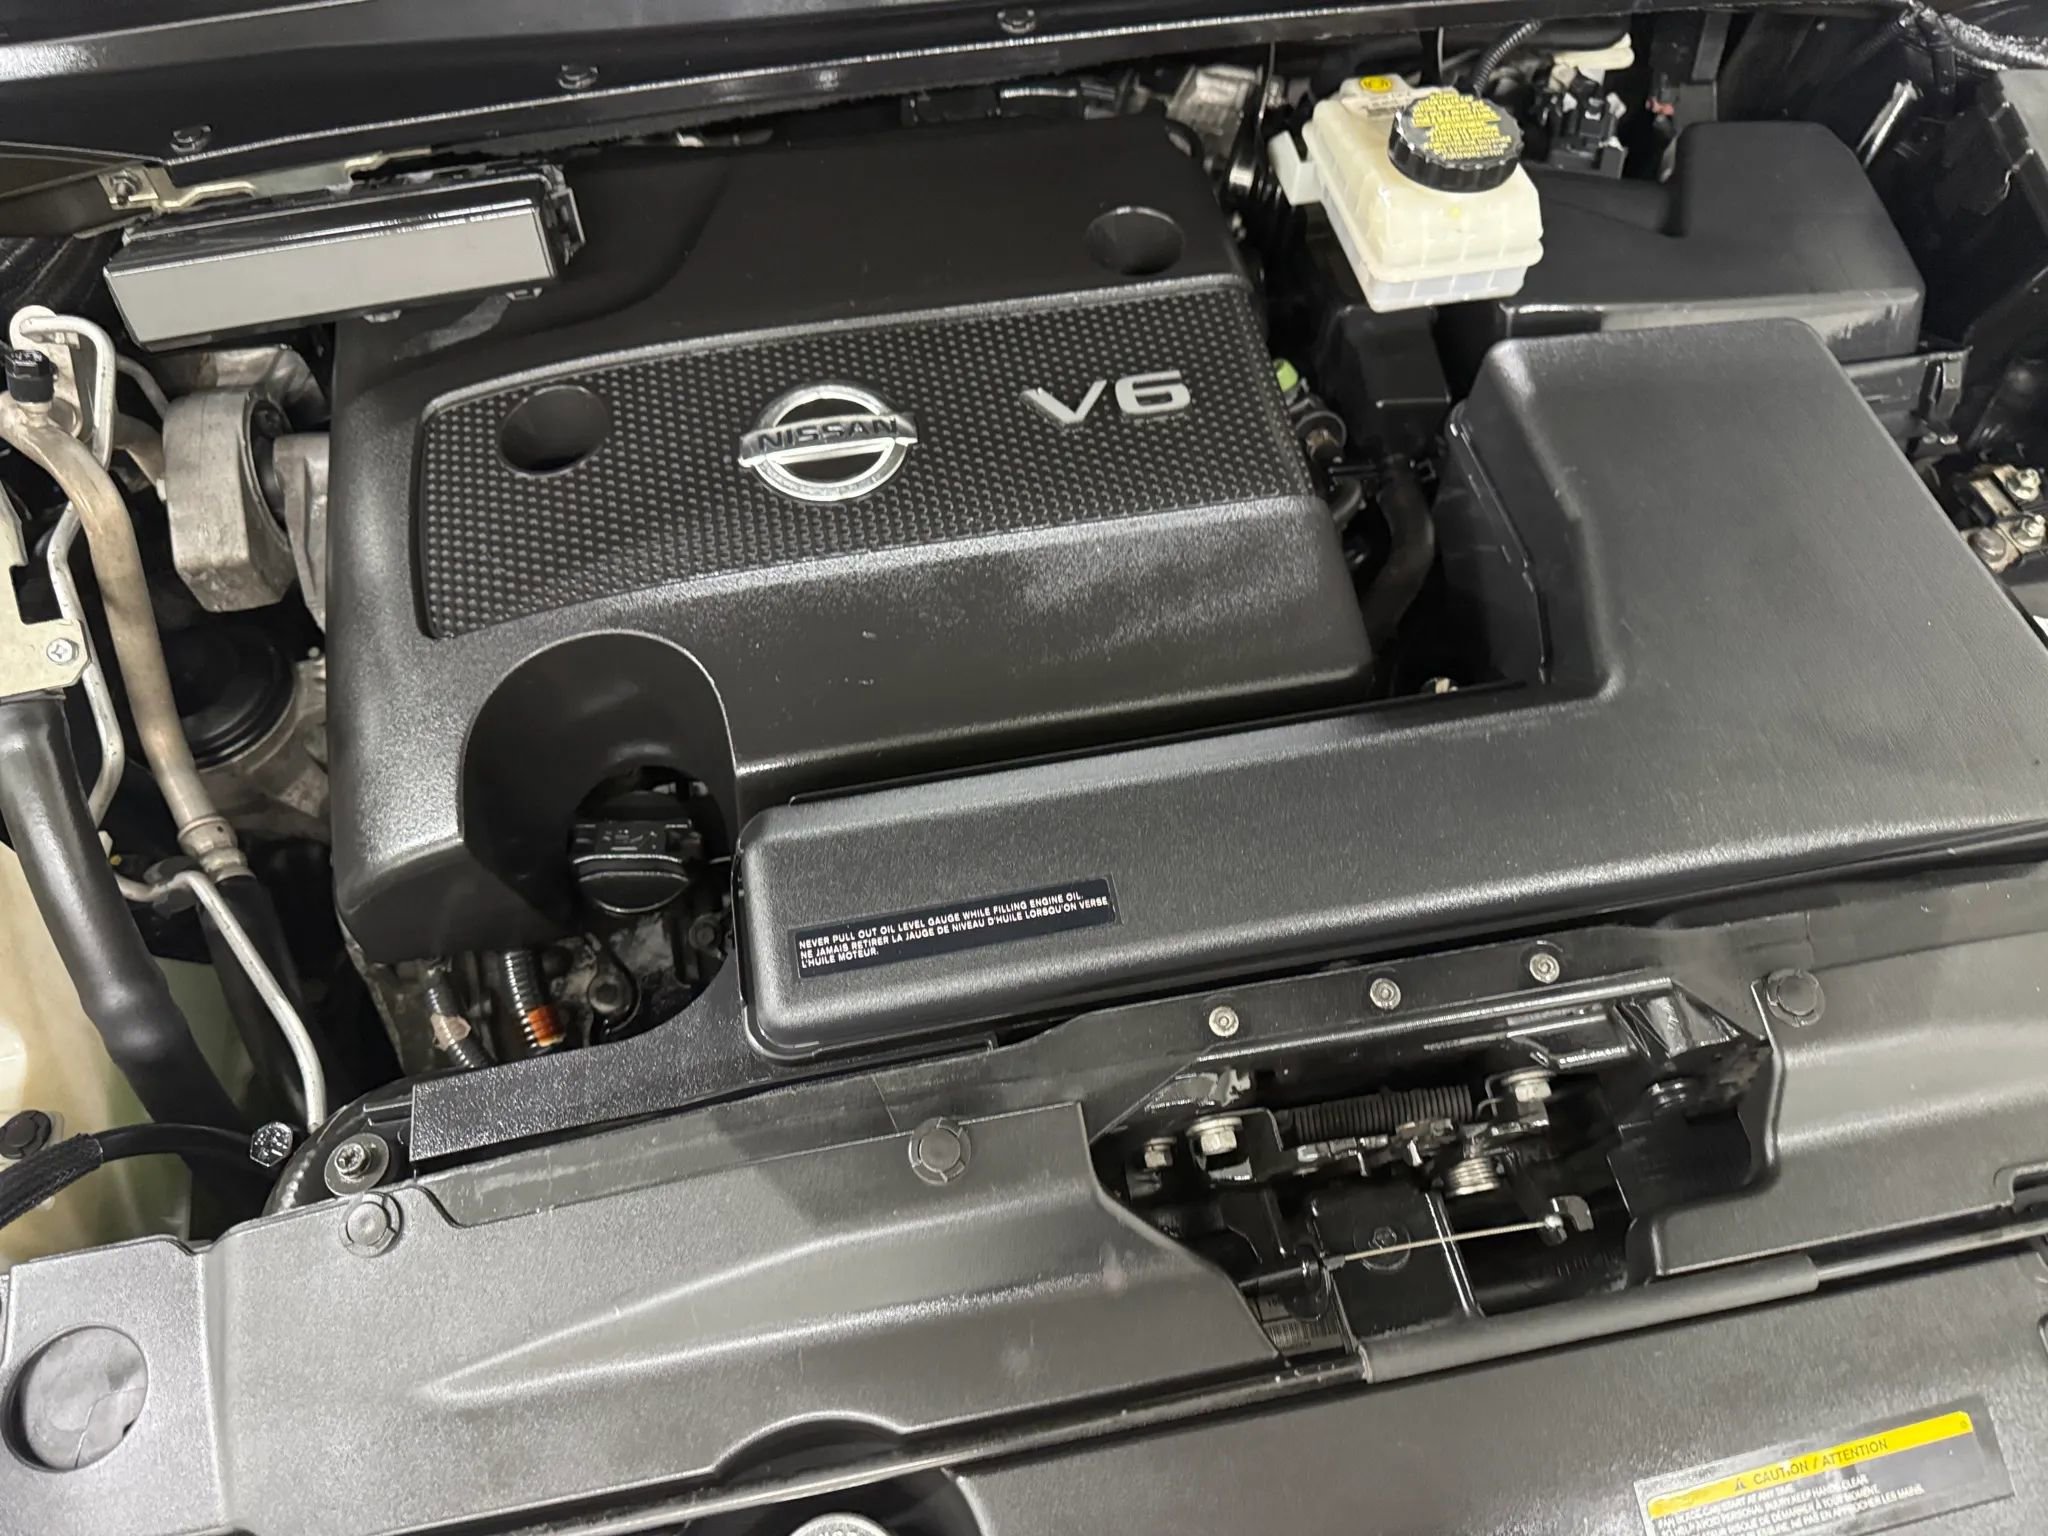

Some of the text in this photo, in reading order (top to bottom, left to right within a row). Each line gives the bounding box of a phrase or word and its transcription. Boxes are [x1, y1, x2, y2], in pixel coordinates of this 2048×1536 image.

[1020, 369, 1192, 430] V6
[759, 416, 898, 450] NISSAN
[799, 891, 1083, 949] NEVER PULL OUT OIL LEVEL GAUGE WHILE FILLING ENGINE OIL.
[801, 896, 1108, 959] NE JAMAIS RETIRER LA JAUGE DE NIVEAU D'HUILE LORSQU'ON VERSE
[801, 947, 879, 969] L'HUILE MOTEUR.
[1822, 1438, 1889, 1467] ATTENTION
